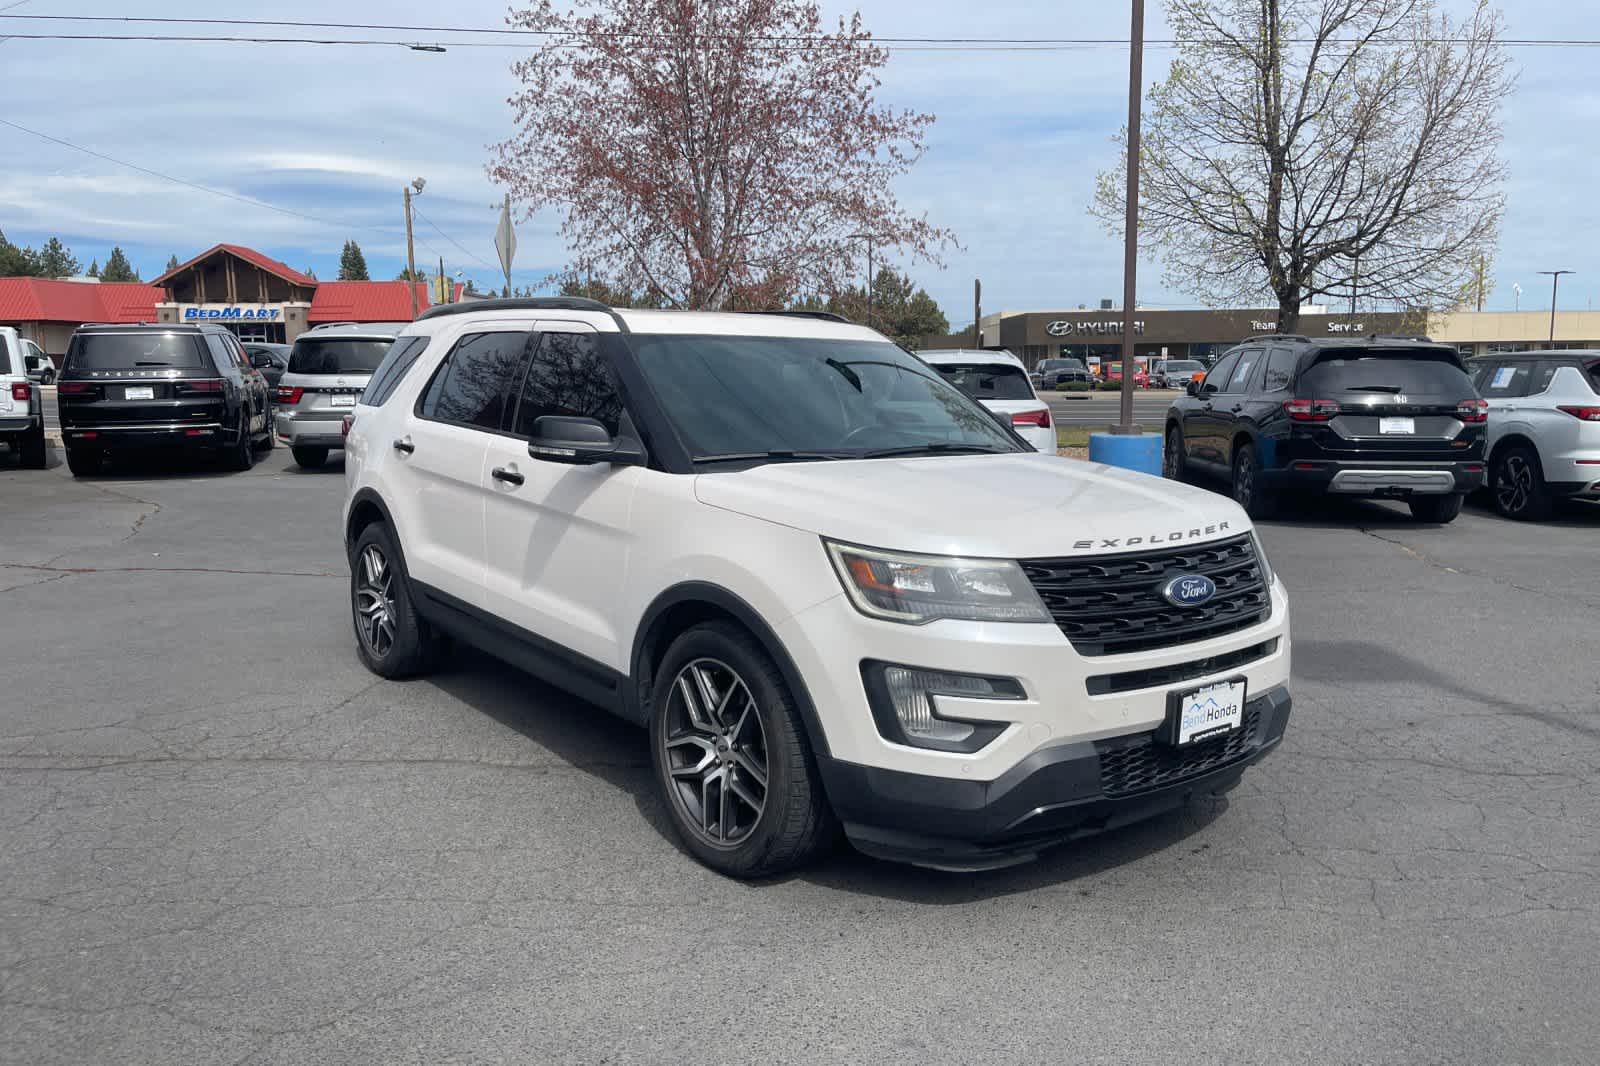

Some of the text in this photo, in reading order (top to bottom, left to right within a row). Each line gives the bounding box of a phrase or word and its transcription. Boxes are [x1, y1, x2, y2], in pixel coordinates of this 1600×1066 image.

[1251, 320, 1276, 330] Team
[1073, 521, 1229, 549] EXPLORER
[1181, 580, 1208, 599] Ford
